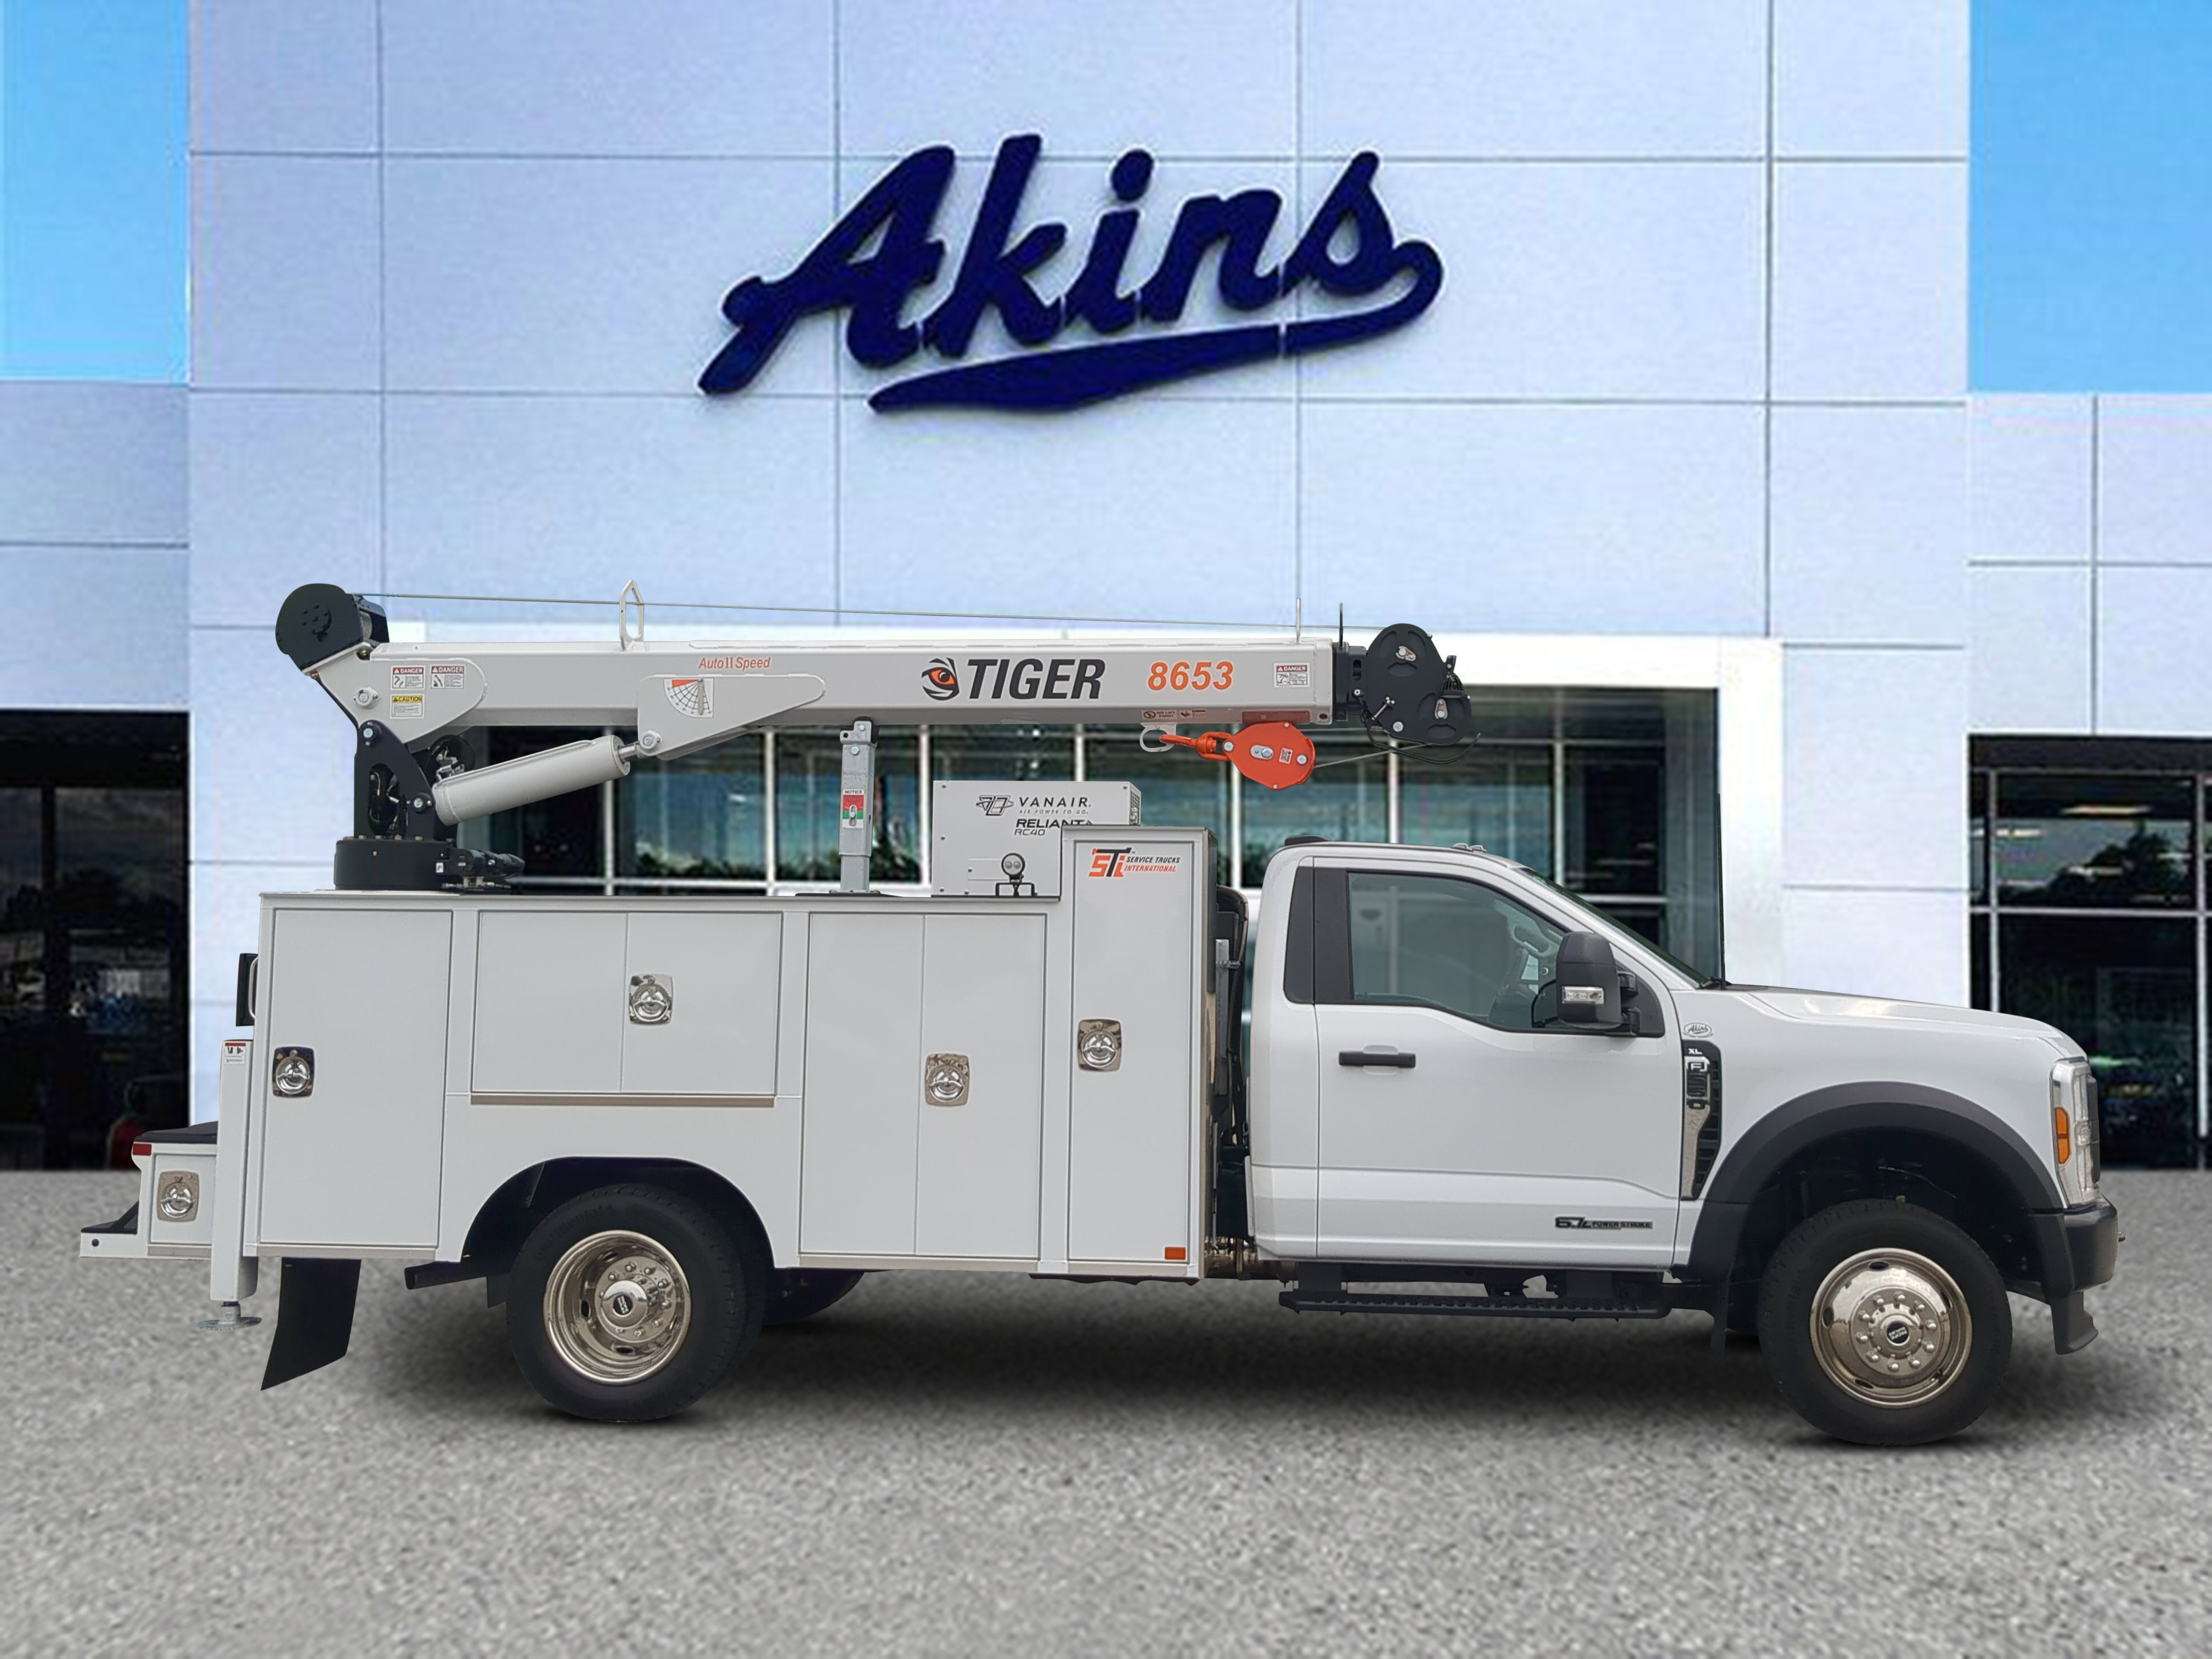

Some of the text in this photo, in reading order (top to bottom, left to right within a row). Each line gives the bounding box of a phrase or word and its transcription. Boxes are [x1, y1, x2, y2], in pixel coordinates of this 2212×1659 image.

[698, 133, 1443, 413] Akins
[698, 658, 724, 669] Auto
[736, 657, 771, 670] Speed
[967, 658, 1105, 699] TIGER
[1148, 661, 1233, 690] 8653
